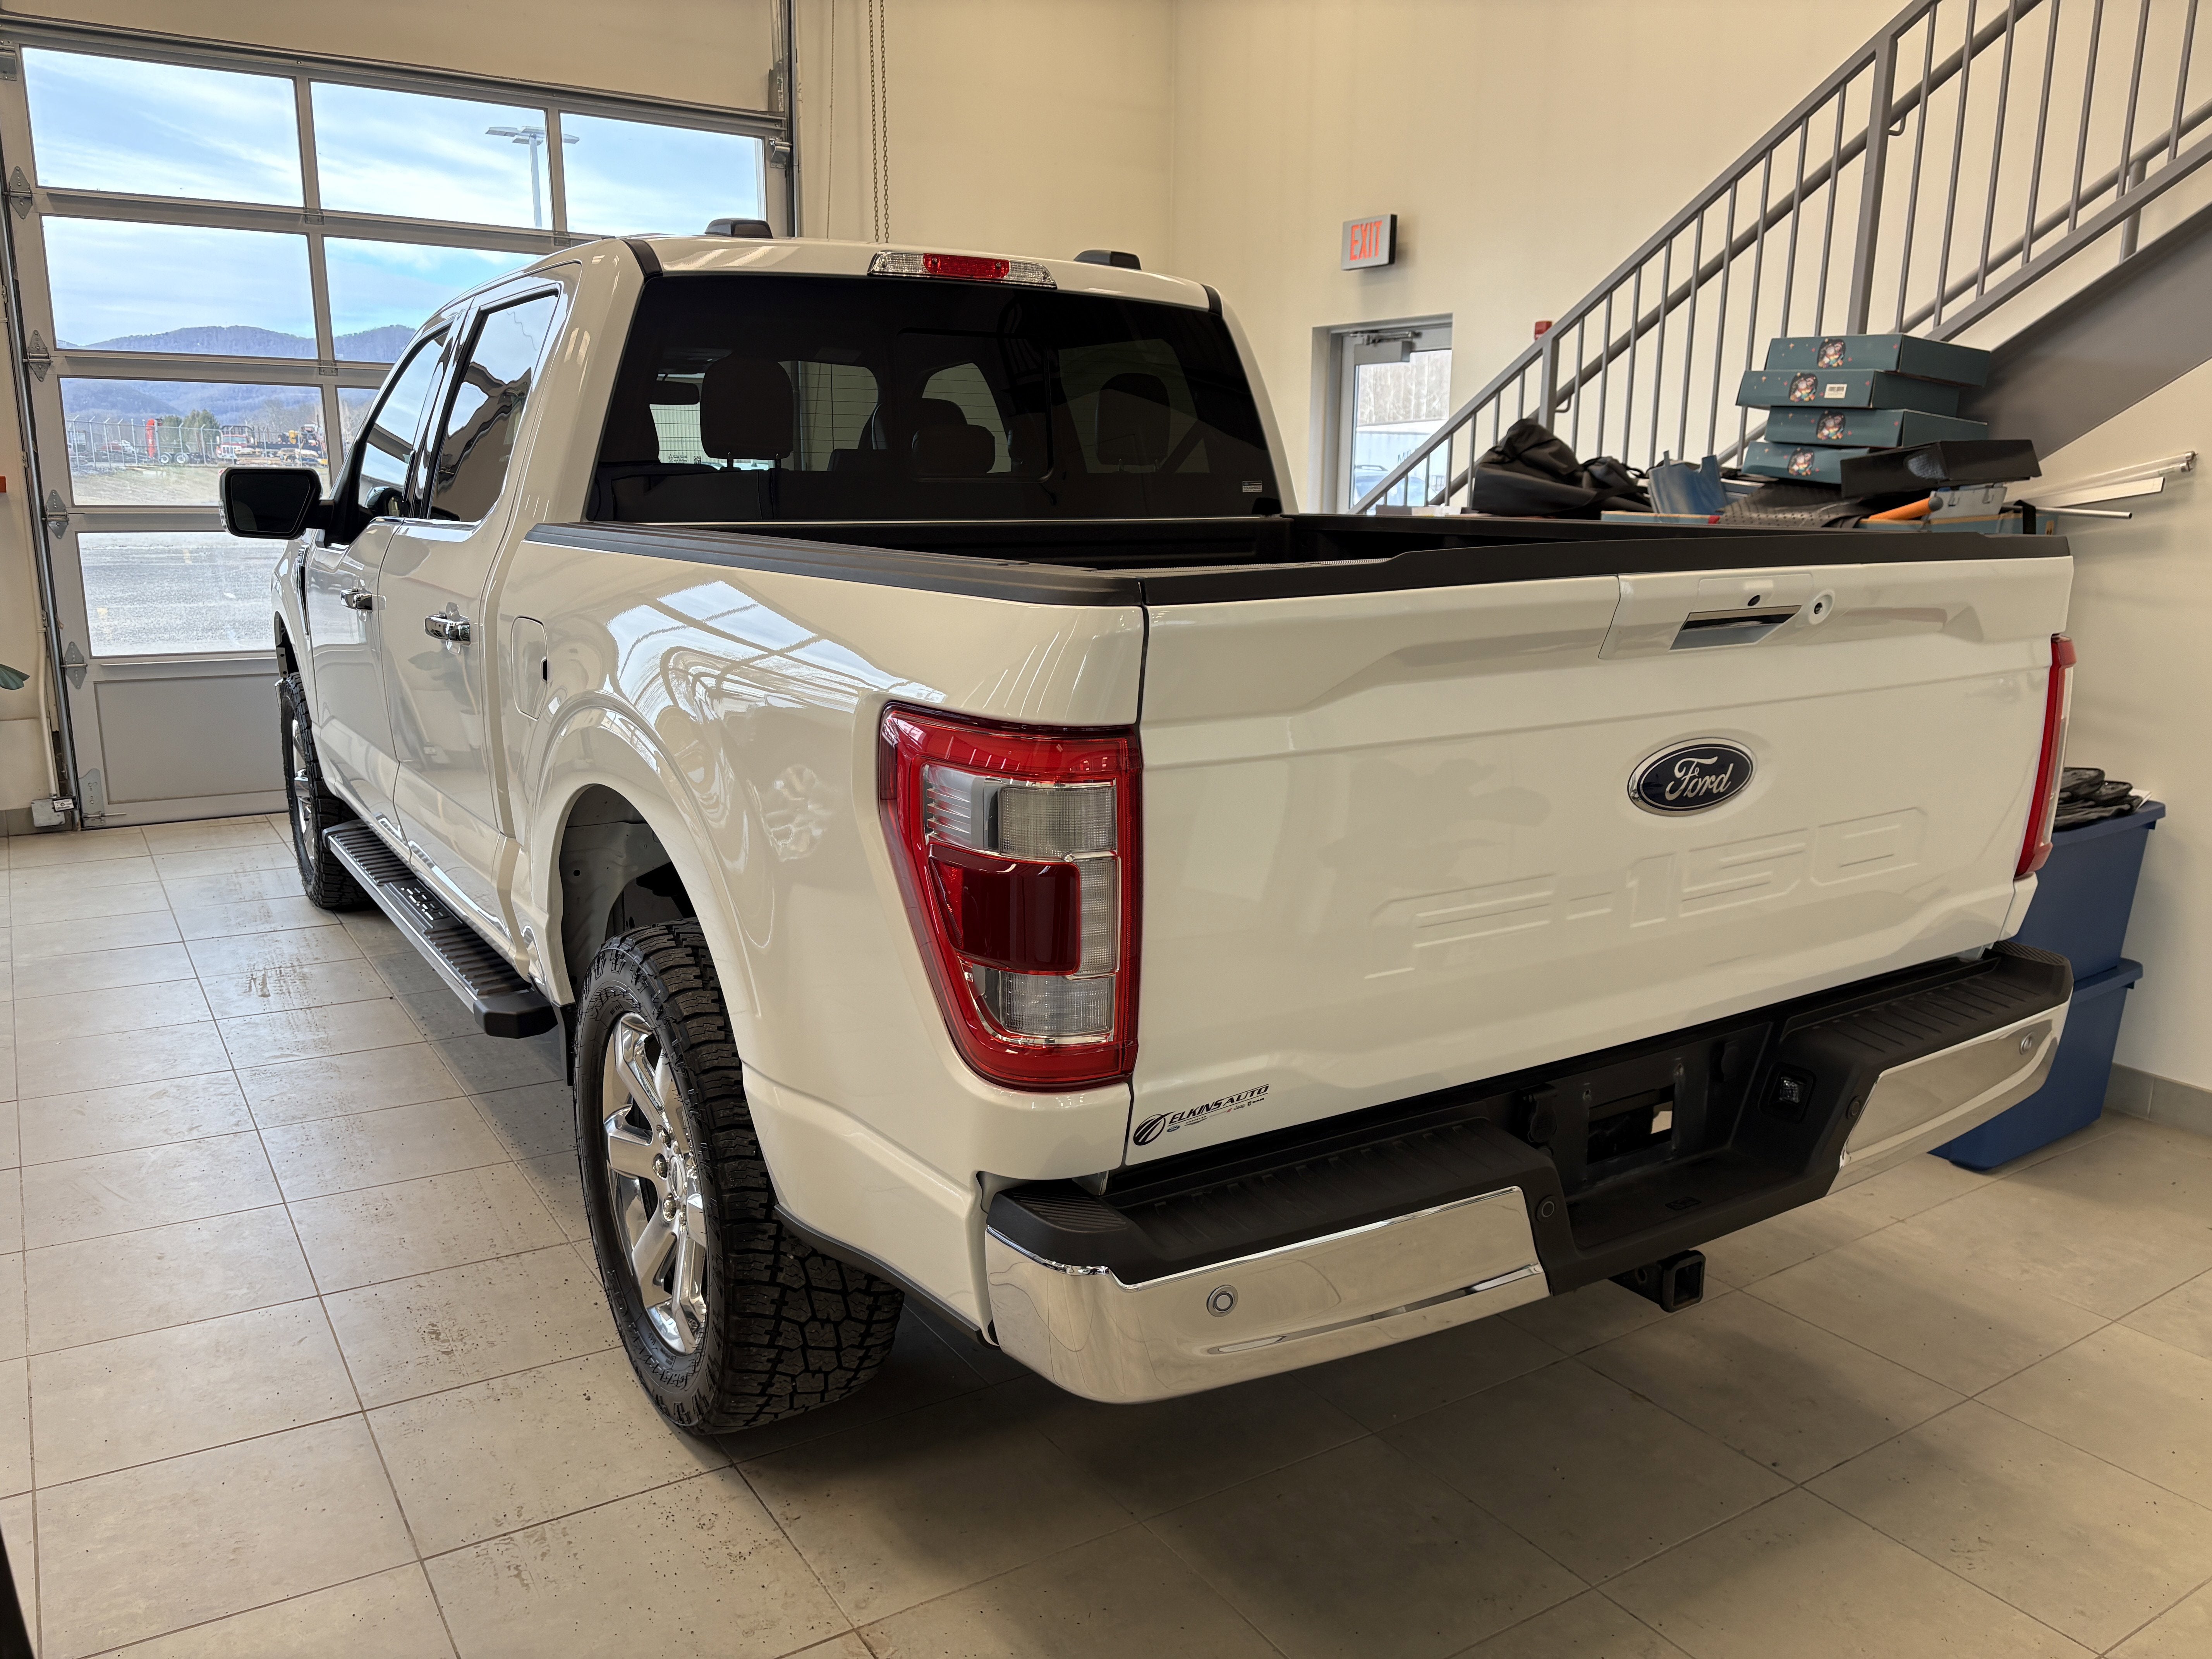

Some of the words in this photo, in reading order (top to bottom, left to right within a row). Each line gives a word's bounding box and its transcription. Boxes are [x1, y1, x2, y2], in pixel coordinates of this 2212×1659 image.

[1350, 220, 1382, 261] EXIT
[1665, 756, 1734, 801] Ford
[1364, 807, 1928, 979] F-150
[1169, 1099, 1224, 1124] ELKINS
[1223, 1085, 1269, 1106] AUTO
